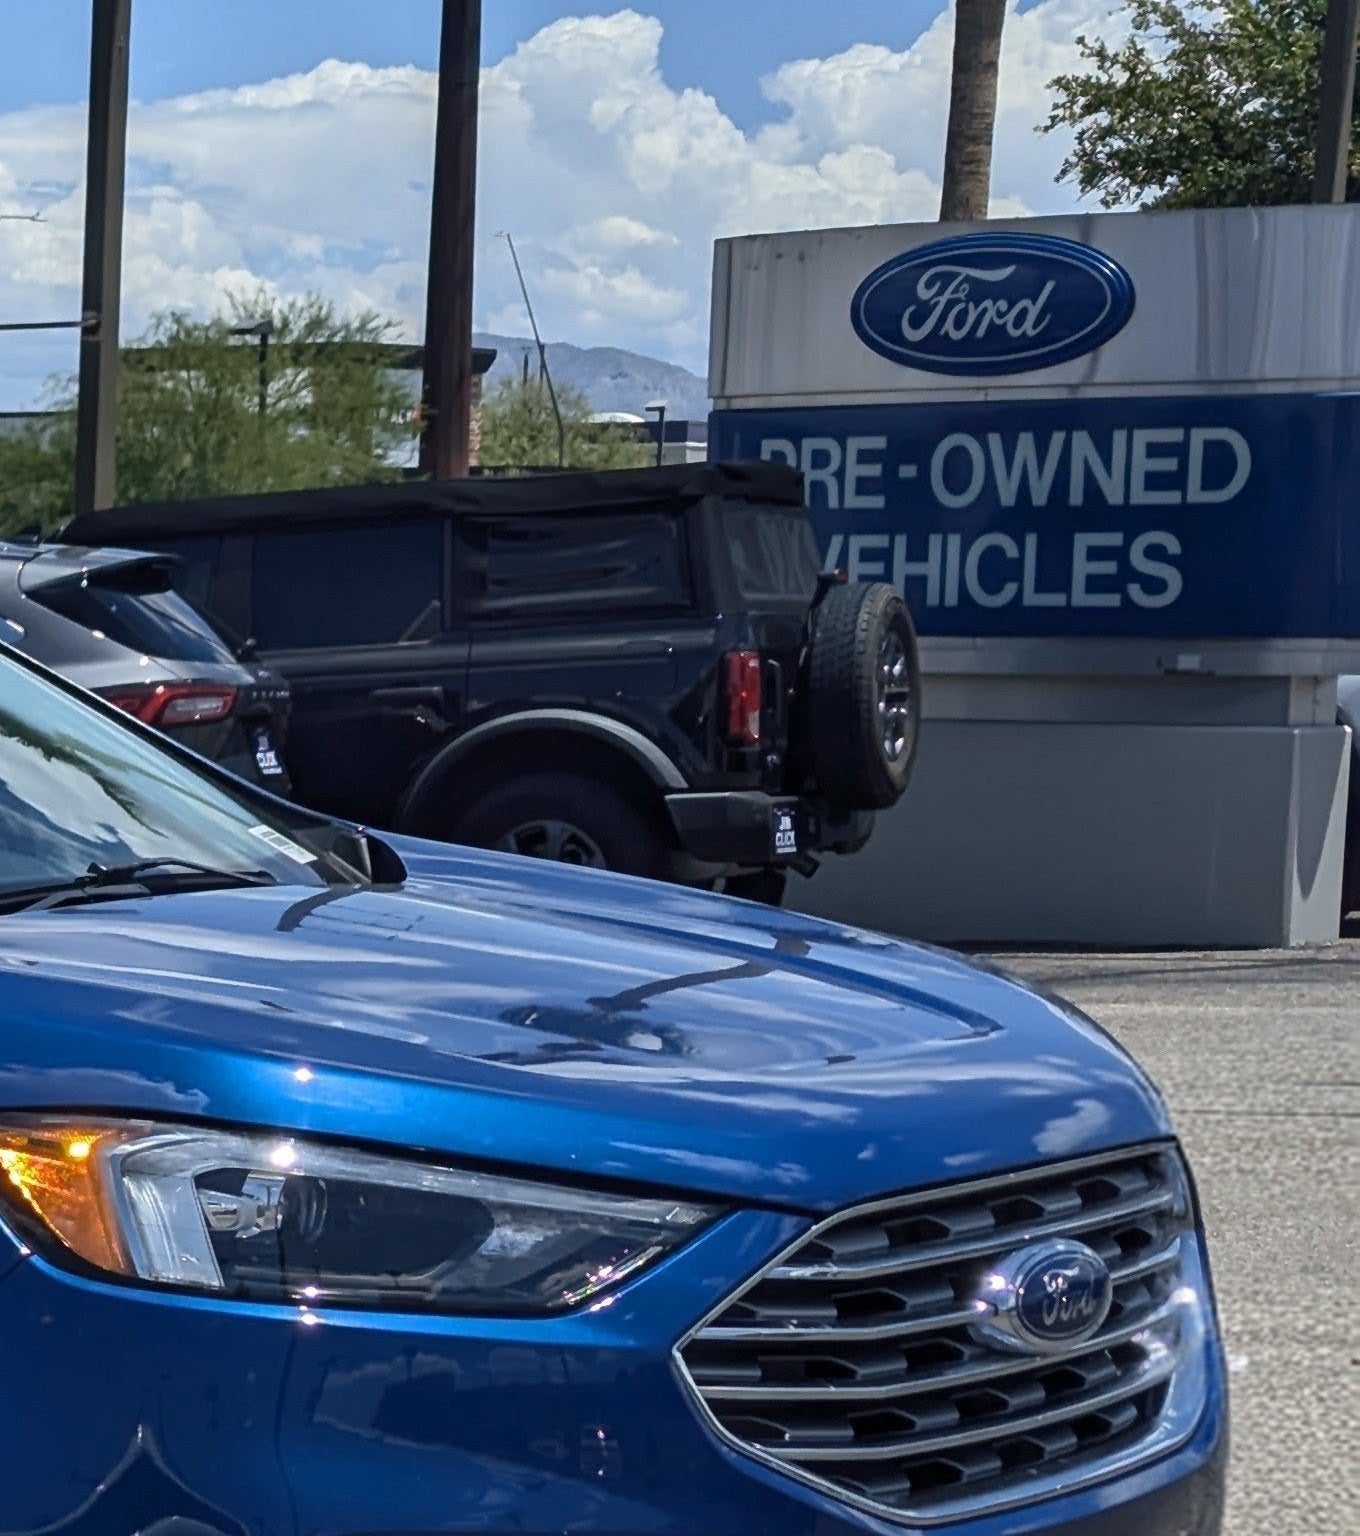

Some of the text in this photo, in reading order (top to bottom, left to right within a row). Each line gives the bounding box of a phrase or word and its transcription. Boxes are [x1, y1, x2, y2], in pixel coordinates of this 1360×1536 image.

[901, 264, 1055, 342] Ford
[822, 530, 1183, 609] EHICLES
[1041, 1265, 1095, 1327] Ford
